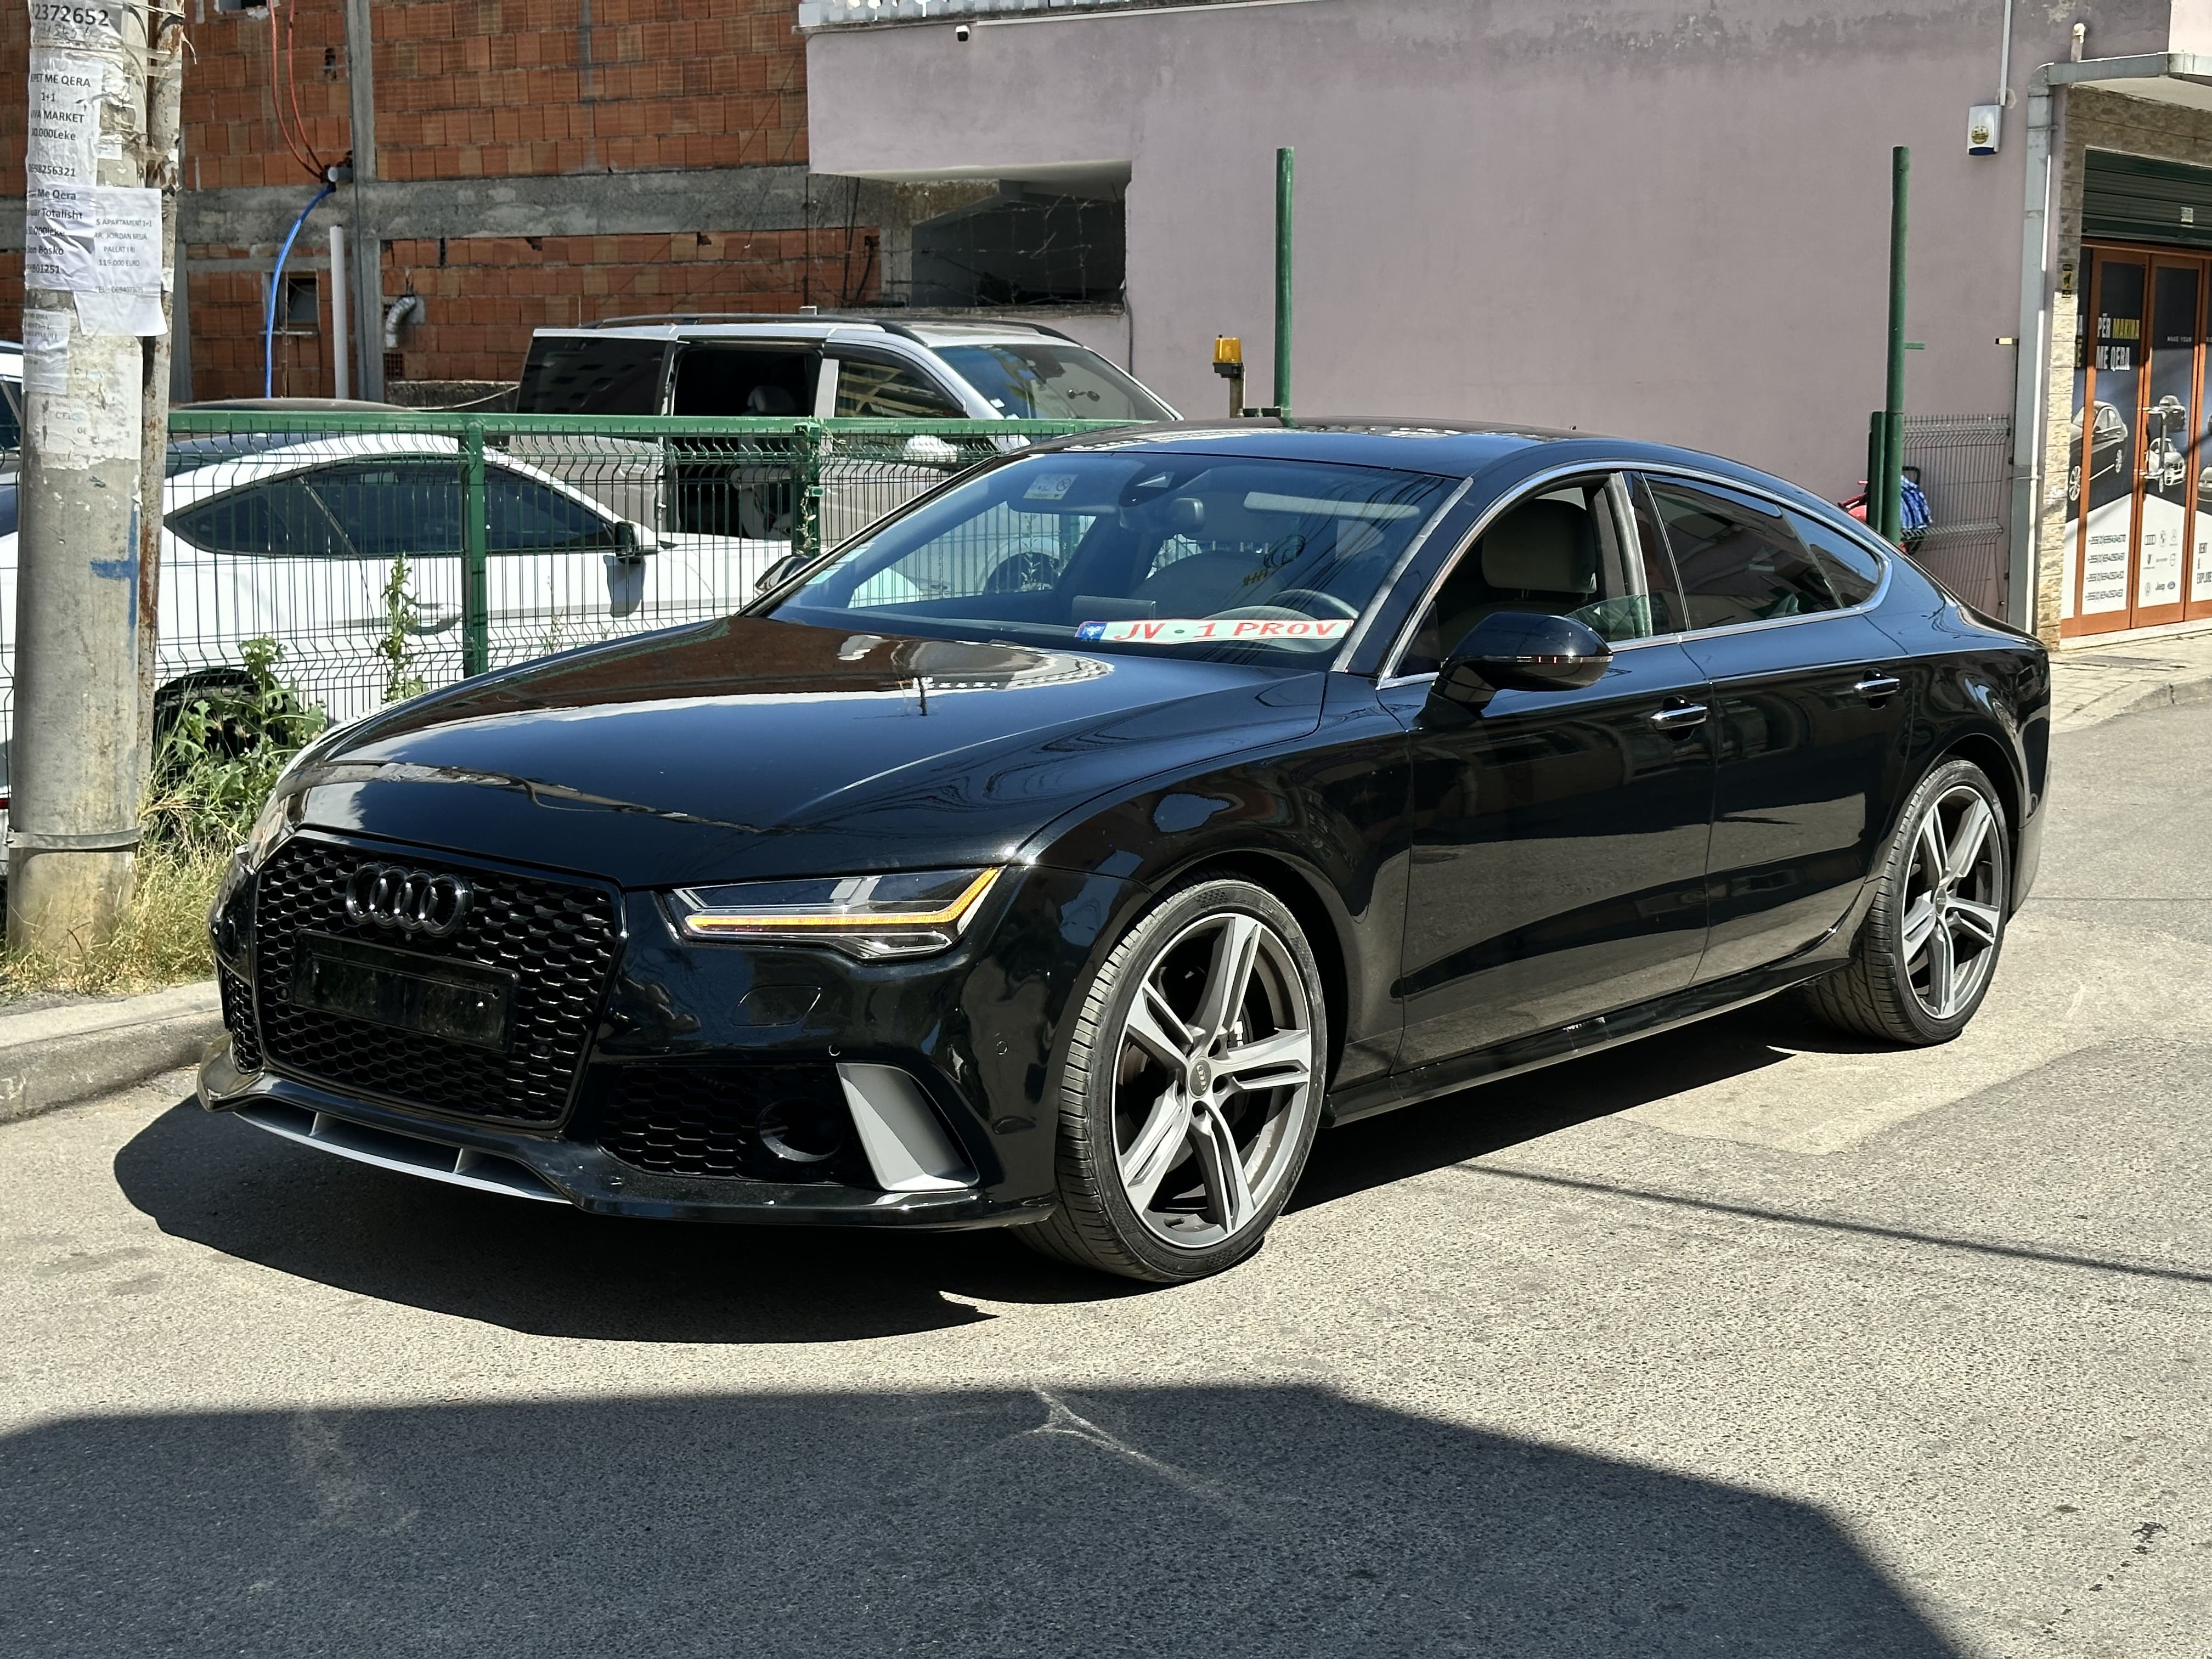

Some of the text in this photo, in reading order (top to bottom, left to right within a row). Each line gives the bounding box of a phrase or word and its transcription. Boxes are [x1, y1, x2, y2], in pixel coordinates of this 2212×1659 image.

[44, 74, 59, 83] ME
[61, 75, 91, 87] QERA
[41, 92, 55, 102] 1+1
[44, 110, 85, 123] MARKET
[37, 188, 50, 198] Me
[53, 189, 76, 200] Qera
[42, 207, 83, 220] Totalisht
[38, 245, 64, 255] Bosko
[1114, 622, 1338, 641] JV 1 PROV
